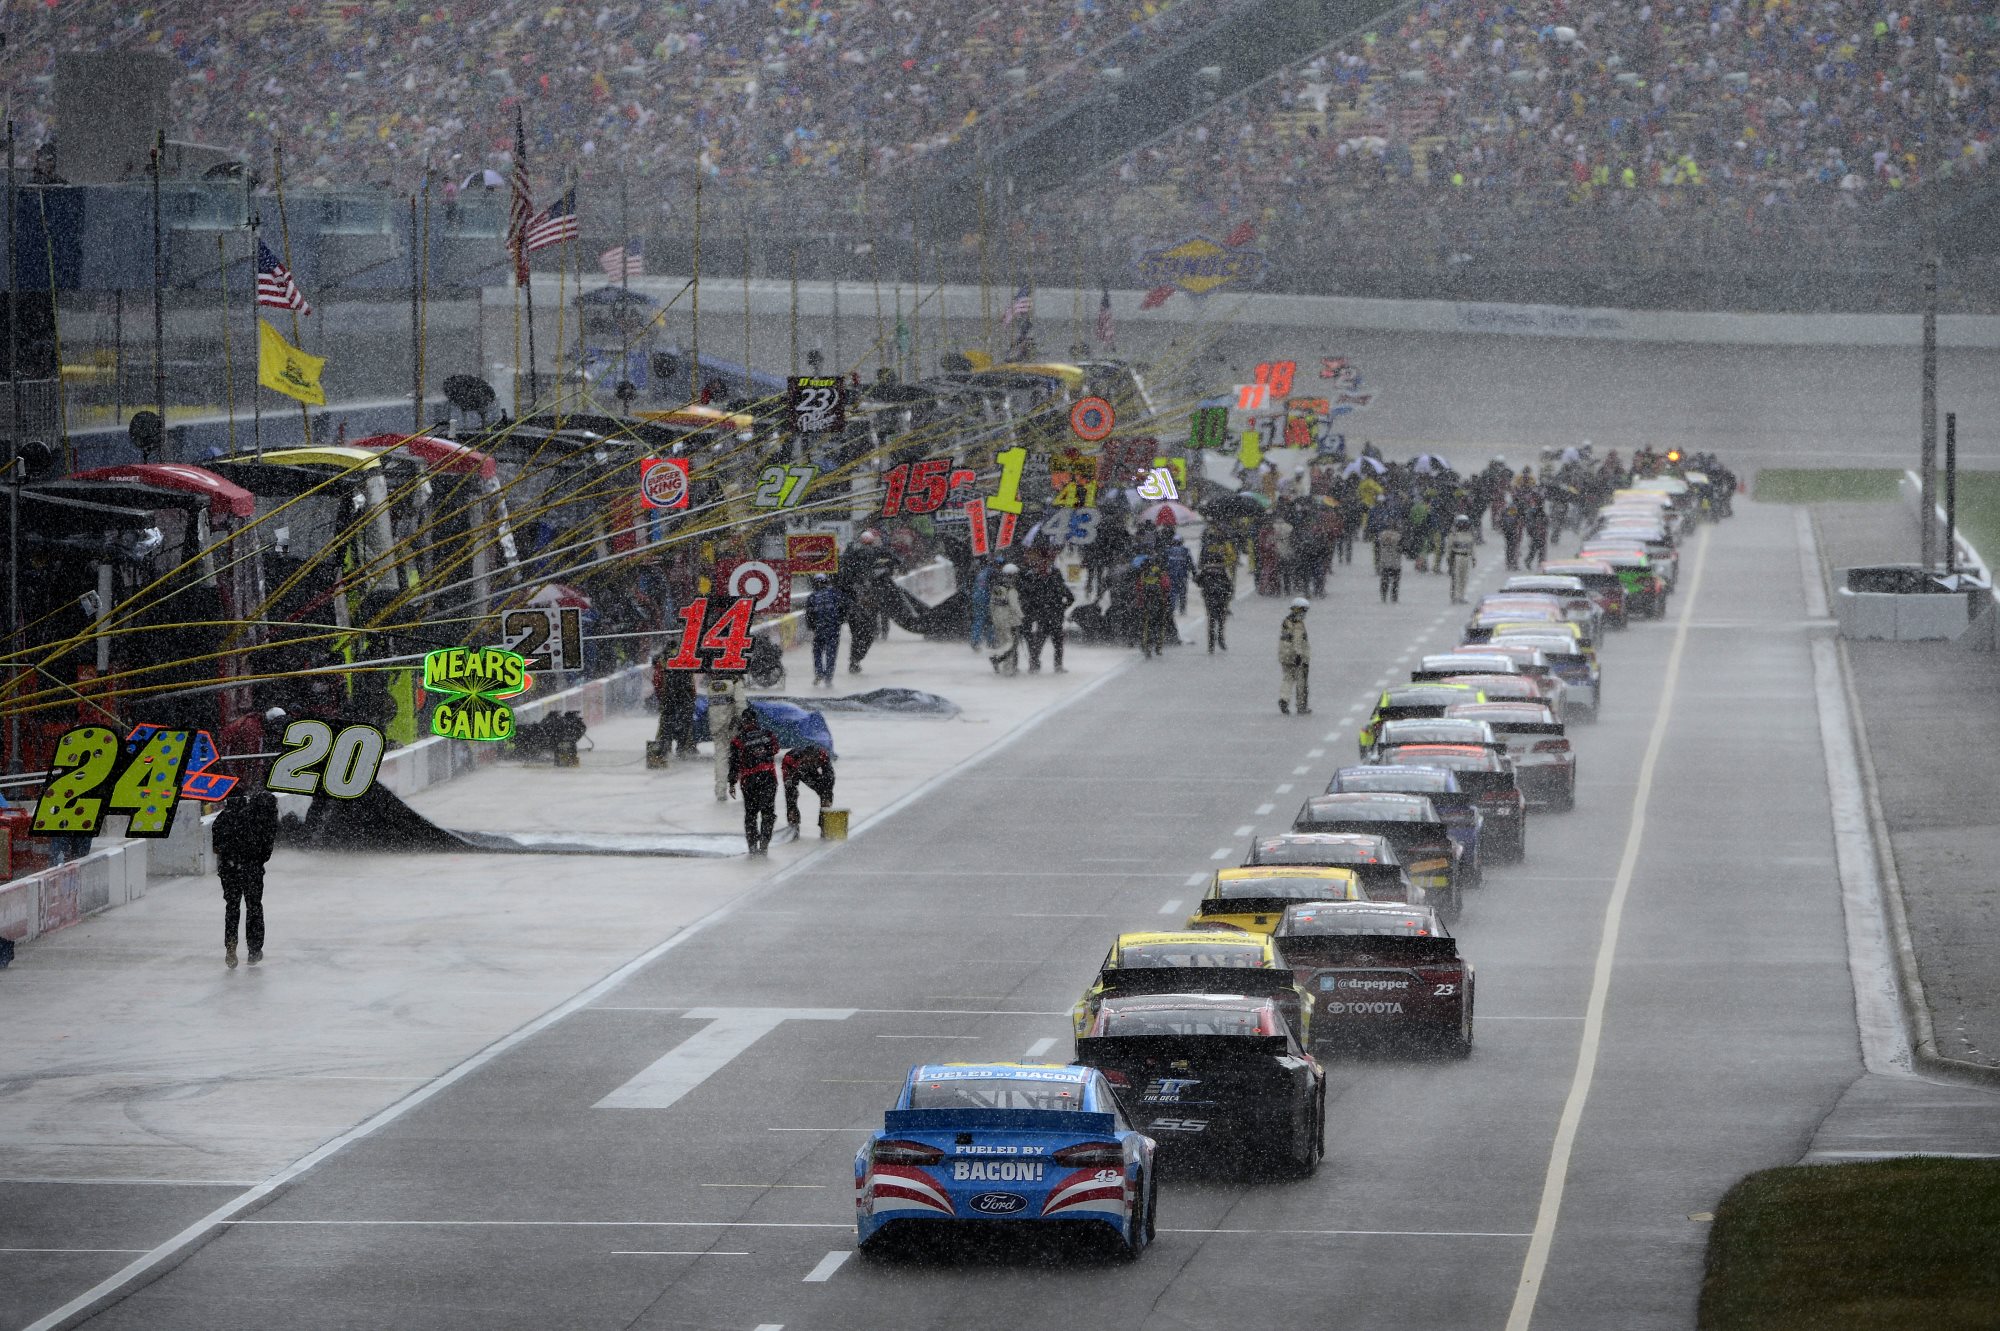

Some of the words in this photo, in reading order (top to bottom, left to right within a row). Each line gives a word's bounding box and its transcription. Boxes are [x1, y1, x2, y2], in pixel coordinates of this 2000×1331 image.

[1254, 361, 1297, 398] 18
[796, 388, 831, 411] 23
[1185, 407, 1227, 449] 10
[650, 478, 682, 497] KING
[752, 465, 817, 508] 27
[882, 459, 951, 517] 15
[986, 447, 1026, 514] 1
[1137, 468, 1178, 499] 31
[1041, 507, 1100, 545] 43
[503, 608, 582, 671] 21
[667, 597, 754, 670] 14
[427, 650, 522, 686] MEARS
[434, 705, 510, 738] GANG
[268, 720, 384, 798] 20
[32, 725, 193, 838] 24
[1337, 978, 1410, 991] @drpepper
[1433, 983, 1456, 997] 23
[1347, 1002, 1404, 1014] TOYOTA
[1014, 1070, 1082, 1082] BACON
[955, 1145, 1018, 1155] FUELED
[1022, 1145, 1045, 1156] BY
[953, 1161, 1044, 1182] BACON!
[1093, 1168, 1119, 1184] 43
[979, 1193, 1017, 1212] Ford
